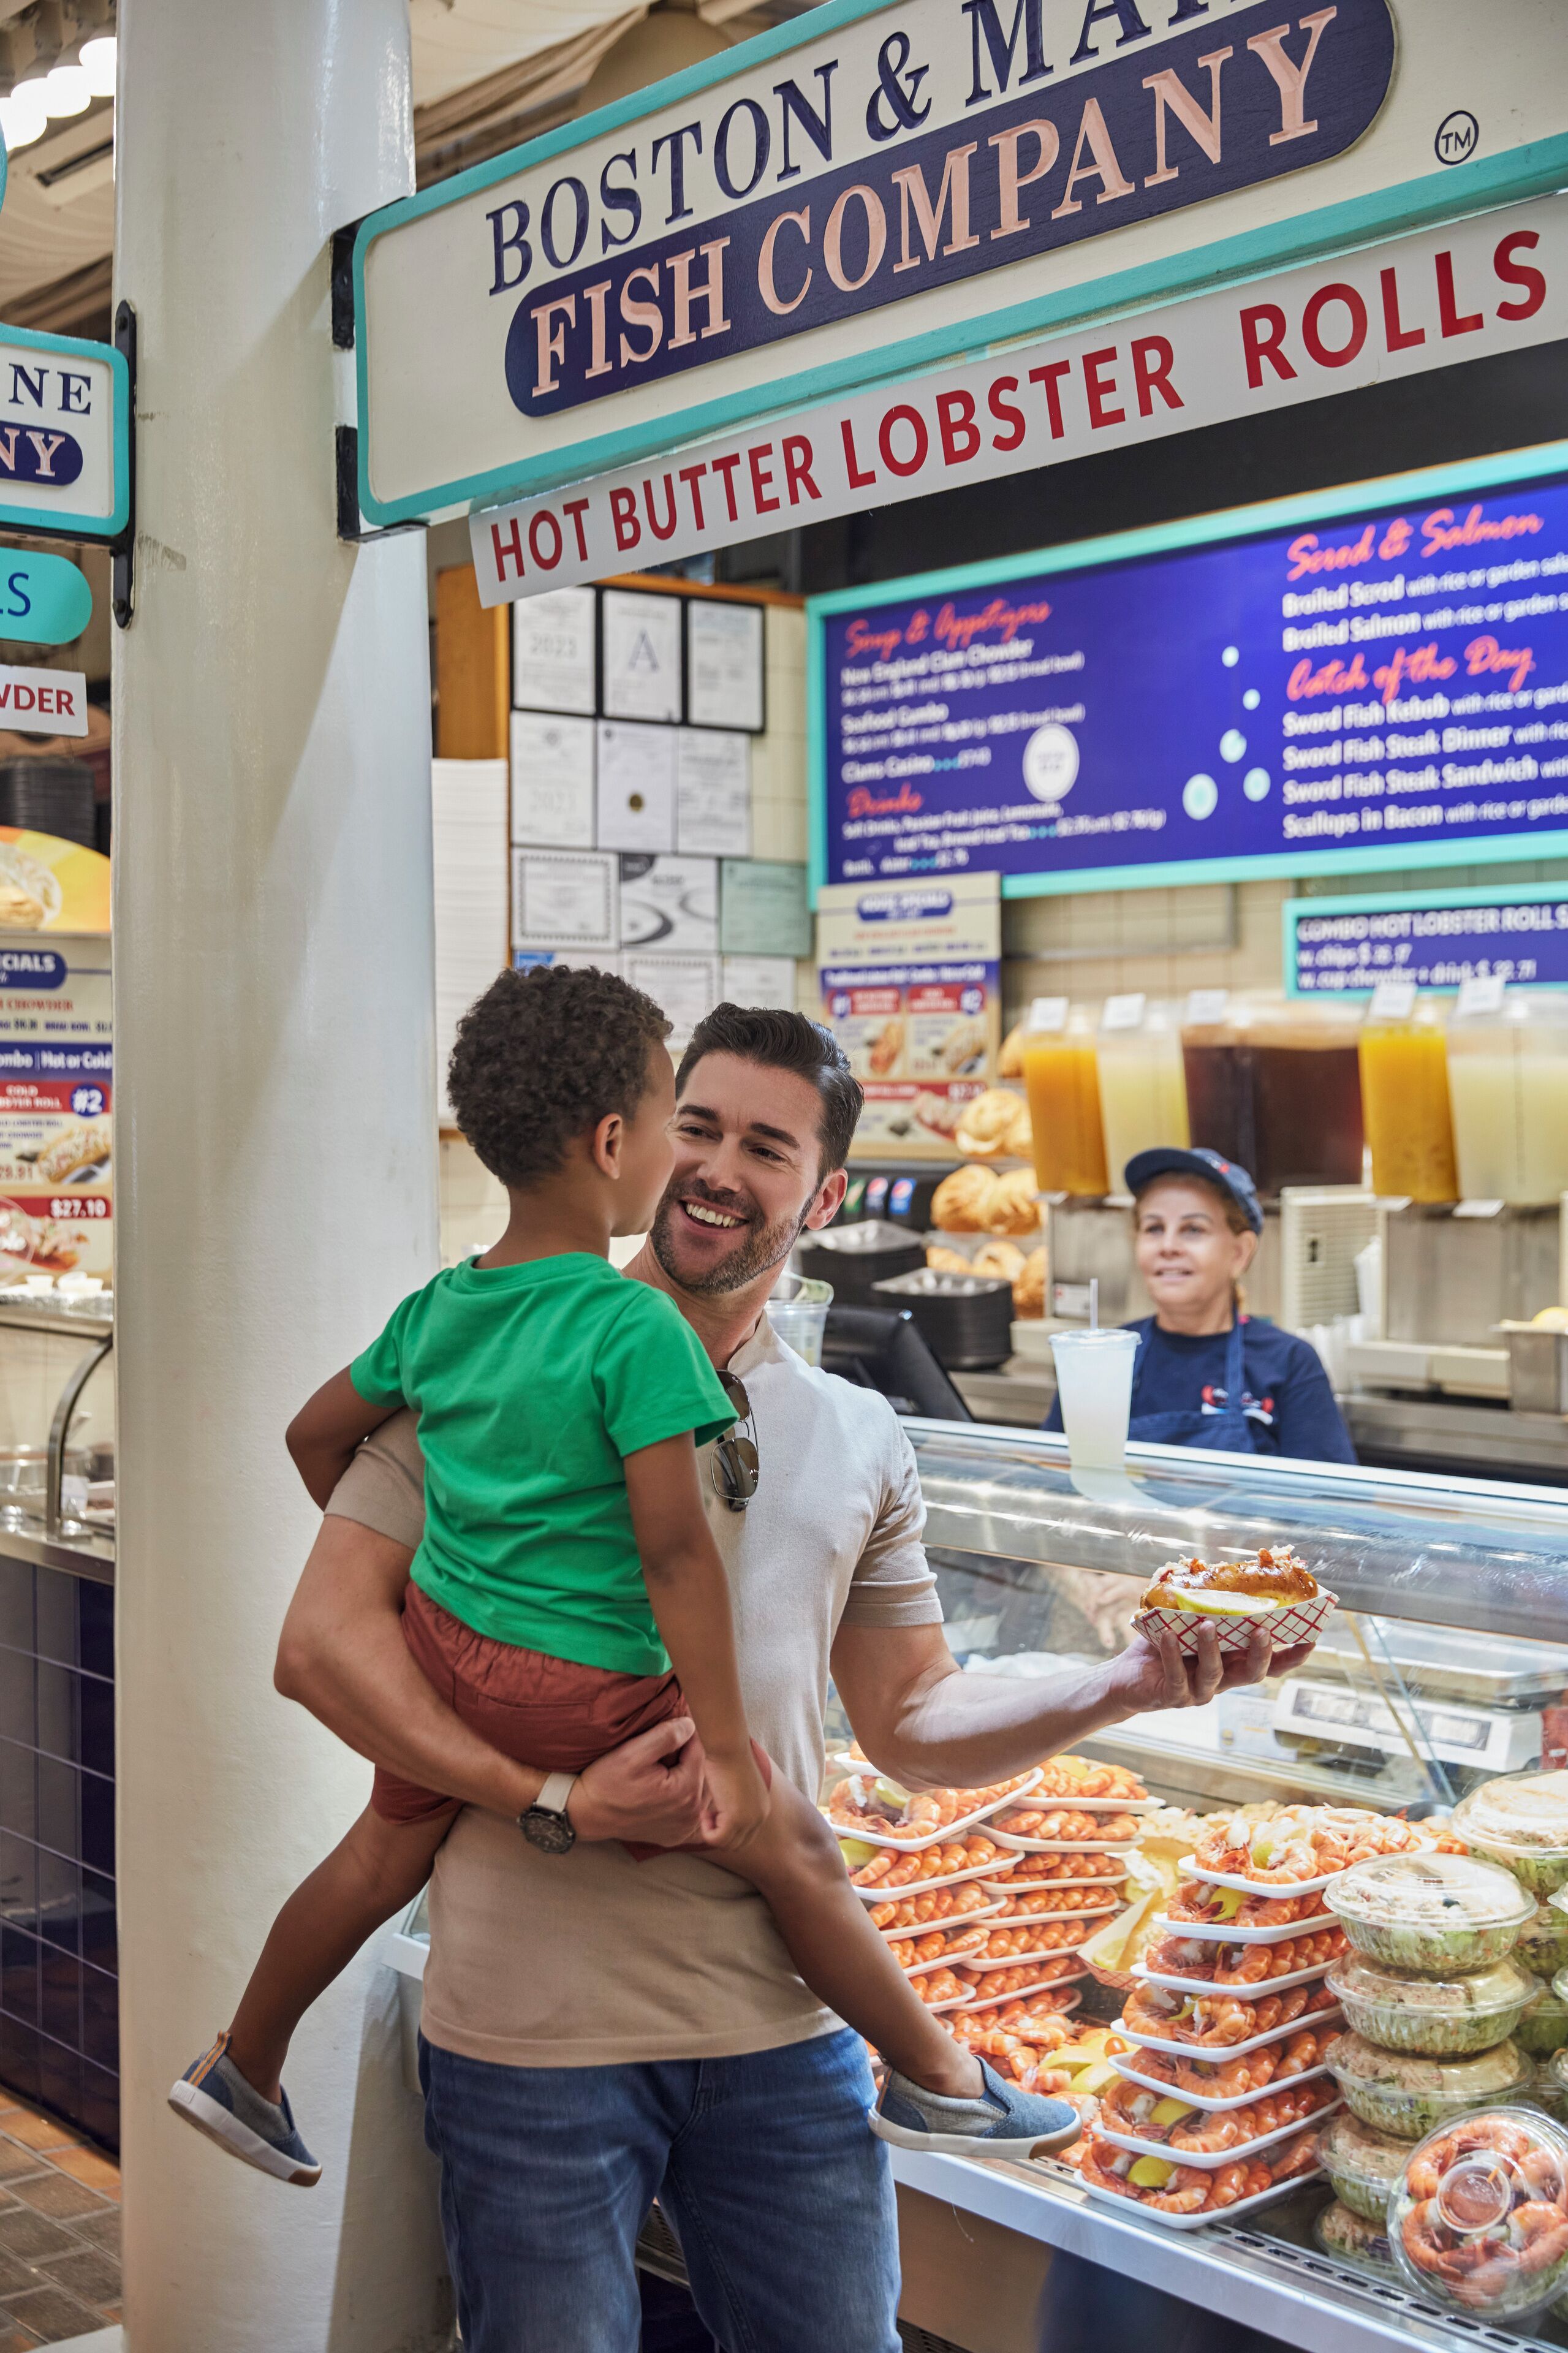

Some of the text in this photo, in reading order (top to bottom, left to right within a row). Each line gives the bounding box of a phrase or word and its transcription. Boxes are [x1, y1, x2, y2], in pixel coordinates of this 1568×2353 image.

[486, 0, 1209, 297] BOSTON & MA
[1440, 125, 1472, 154] TM
[530, 6, 1337, 398] FISH COMPANY
[9, 363, 92, 415] NE
[491, 230, 1547, 582] HOT BUTTER LOBSTER ROLLS
[1420, 504, 1544, 558] Salmon
[0, 572, 31, 617] S
[628, 630, 659, 672] A
[1286, 635, 1536, 705] Catch of the Day
[1412, 907, 1500, 937] LOBSTER
[1501, 905, 1554, 932] ROLL
[73, 1088, 103, 1113] #2
[50, 1198, 107, 1218] $27.10
